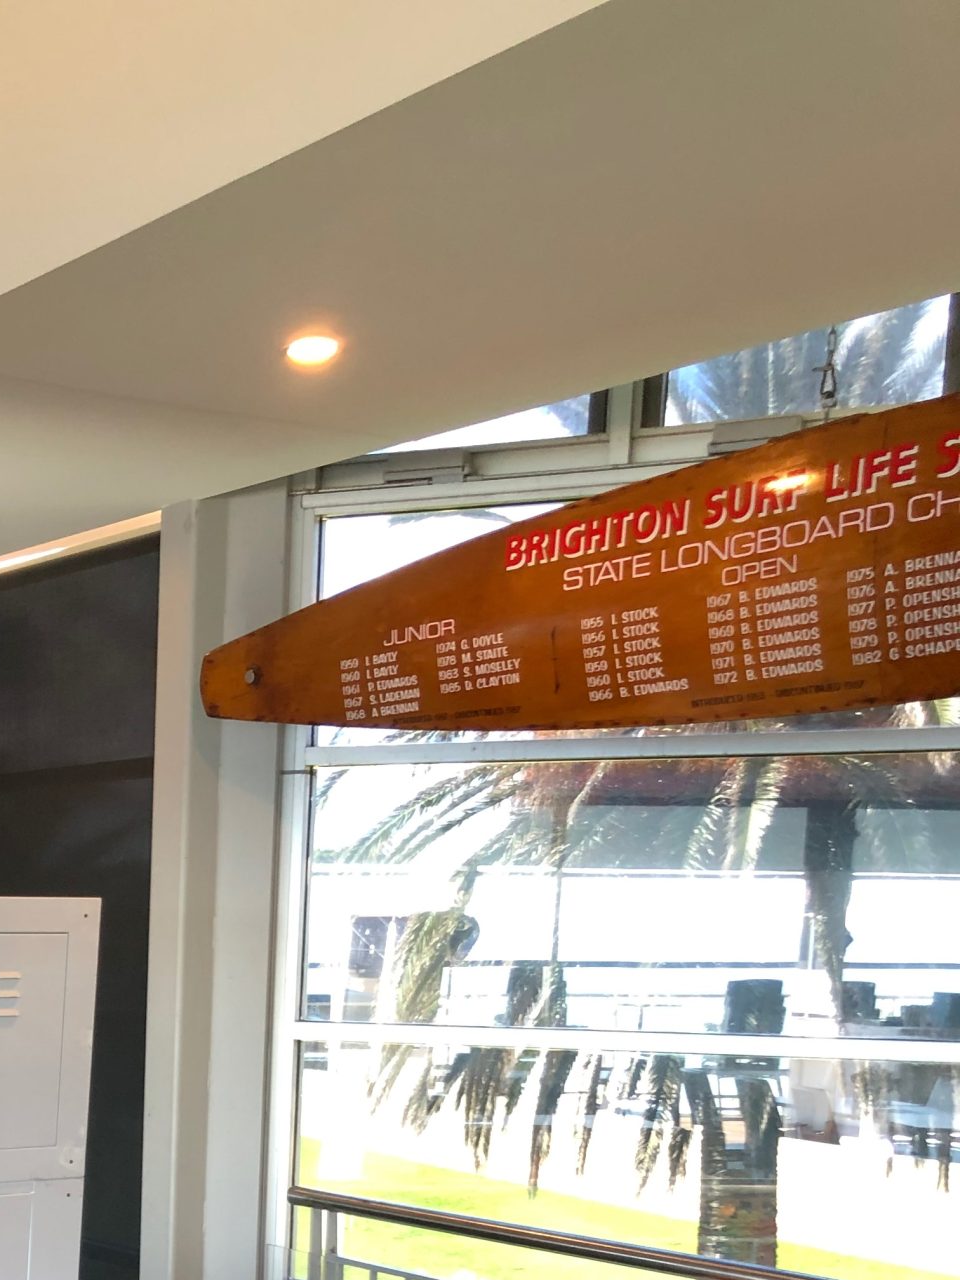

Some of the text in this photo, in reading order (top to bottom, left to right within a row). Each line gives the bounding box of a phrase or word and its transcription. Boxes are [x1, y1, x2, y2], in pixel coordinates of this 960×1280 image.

[504, 497, 690, 572] BRIGHTON
[703, 467, 809, 530] SURF
[824, 444, 920, 502] LIFE
[562, 490, 960, 591] STATE LONGBOARD CH
[722, 555, 797, 586] OPEN
[847, 566, 875, 583] 1975
[884, 563, 899, 577] A.
[706, 577, 818, 608] 1967 B. EDWARDS
[847, 584, 876, 600] 1976
[885, 581, 899, 594] A.
[847, 586, 960, 617] 1977 P. OPENSH
[581, 607, 659, 630] 1955 STOCK
[707, 594, 818, 624] 1968 B. EDWARDS
[849, 603, 960, 633] 1978 P. OPENSH
[383, 618, 455, 646] JUNIOR
[582, 621, 660, 644] 1956 STOCK
[709, 610, 819, 639] 1969 B. EDWARDS
[850, 621, 960, 650] 1979 P. OPENSH
[436, 632, 504, 654] 1974 DOYLE
[583, 636, 662, 659] 1957 STOCK
[710, 627, 820, 655] 1970 B. EDWARDS
[476, 646, 509, 662] STAITE
[584, 652, 663, 673] 1959 STOCK
[712, 643, 822, 670] 1971 B. EDWARDS
[852, 651, 882, 666] 1982
[341, 671, 361, 683] 1960
[475, 658, 521, 676] MOSELEY
[587, 667, 665, 688] 1960 STOCK
[714, 659, 824, 685] 1972 B. EDWARDS
[377, 675, 418, 692] EDWARDS
[476, 672, 521, 690] CLAYTON
[589, 689, 613, 701] 1966
[634, 678, 689, 696] EDWARDS
[344, 696, 363, 709] 1967
[345, 709, 366, 721] 1968
[381, 701, 419, 717] BRENNAN
